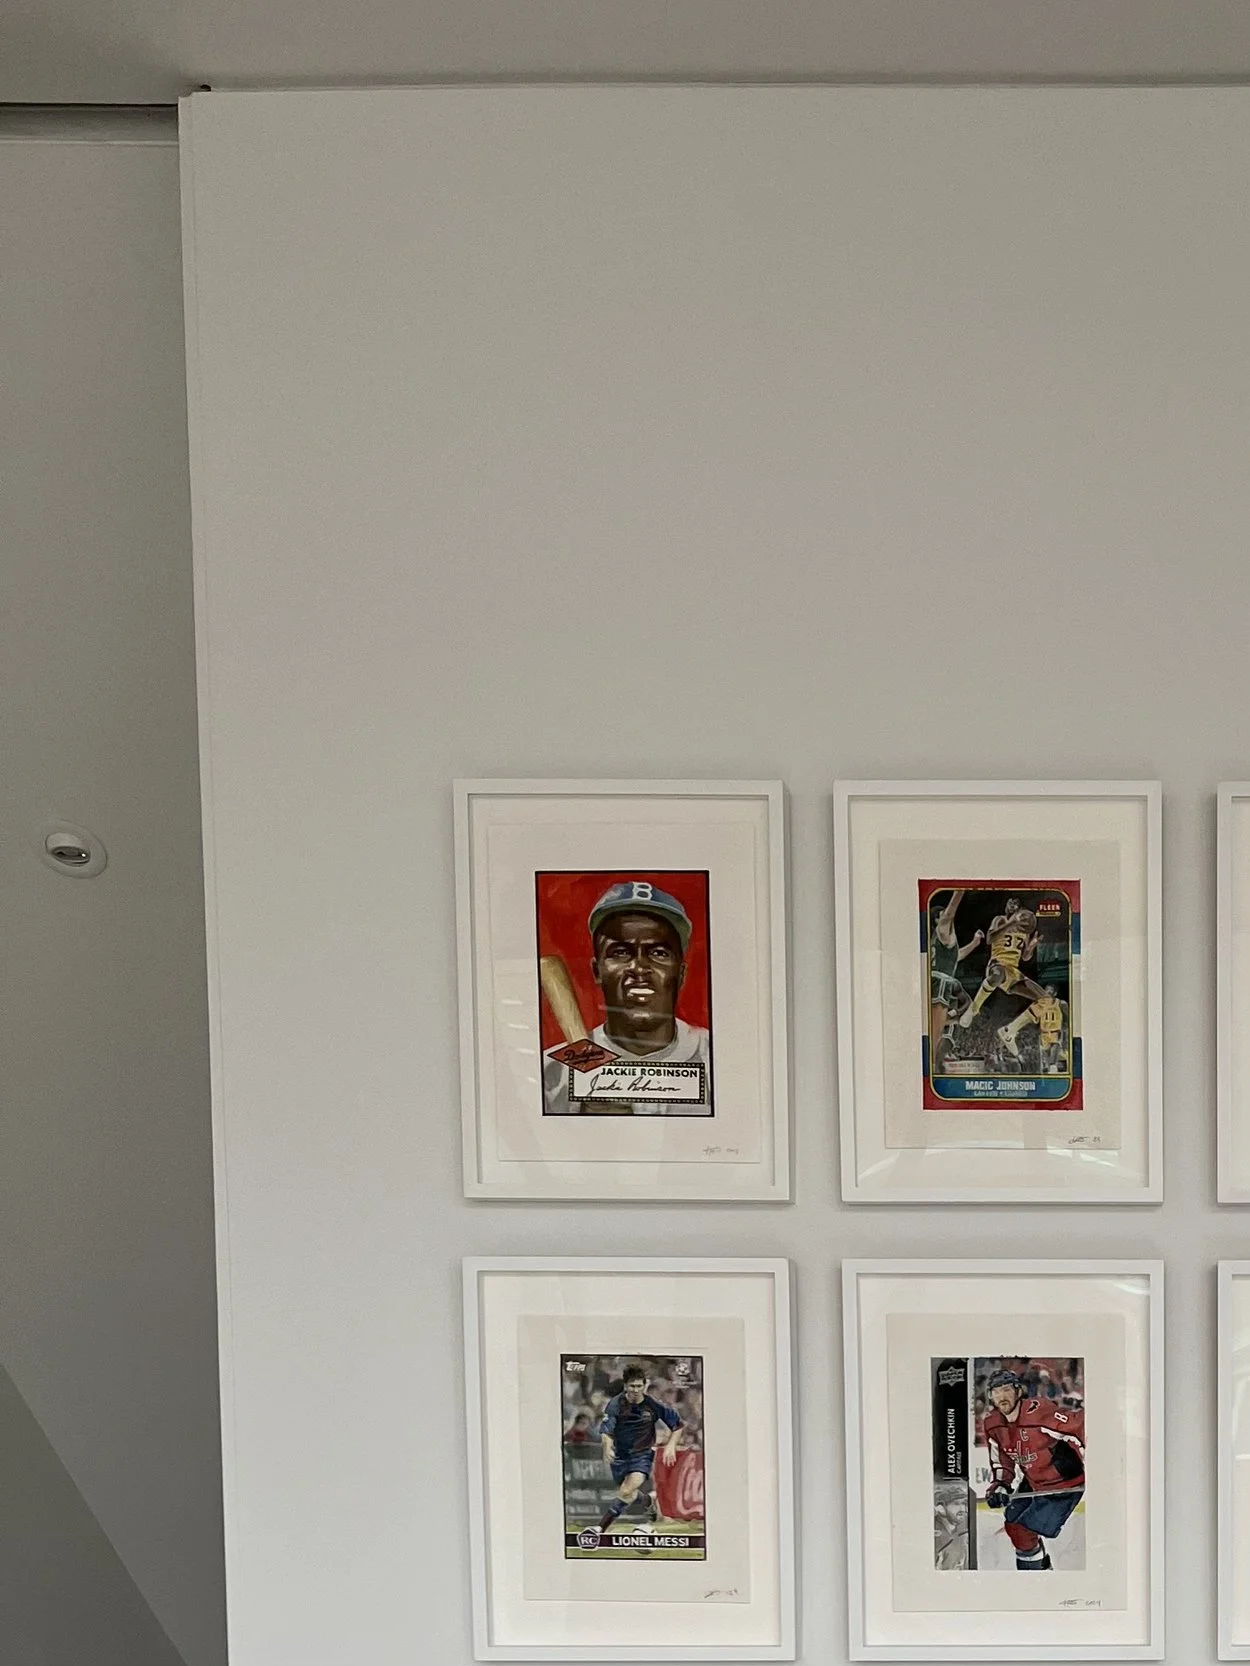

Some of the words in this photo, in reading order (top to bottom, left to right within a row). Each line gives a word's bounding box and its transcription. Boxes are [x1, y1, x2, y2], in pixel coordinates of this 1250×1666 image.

[632, 881, 652, 900] B
[1004, 934, 1024, 949] 32
[1044, 1012, 1055, 1022] 11
[600, 1067, 637, 1078] JACKIE
[640, 1068, 698, 1078] ROBINSON
[996, 1081, 1036, 1091] JOHNSON
[1054, 1411, 1068, 1424] 8
[947, 1408, 956, 1452] OVECHKIN
[1020, 1428, 1029, 1442] C
[947, 1454, 956, 1474] ALEX
[580, 1535, 598, 1546] RC
[612, 1536, 652, 1546] LIONEL
[654, 1536, 689, 1546] MESSI
